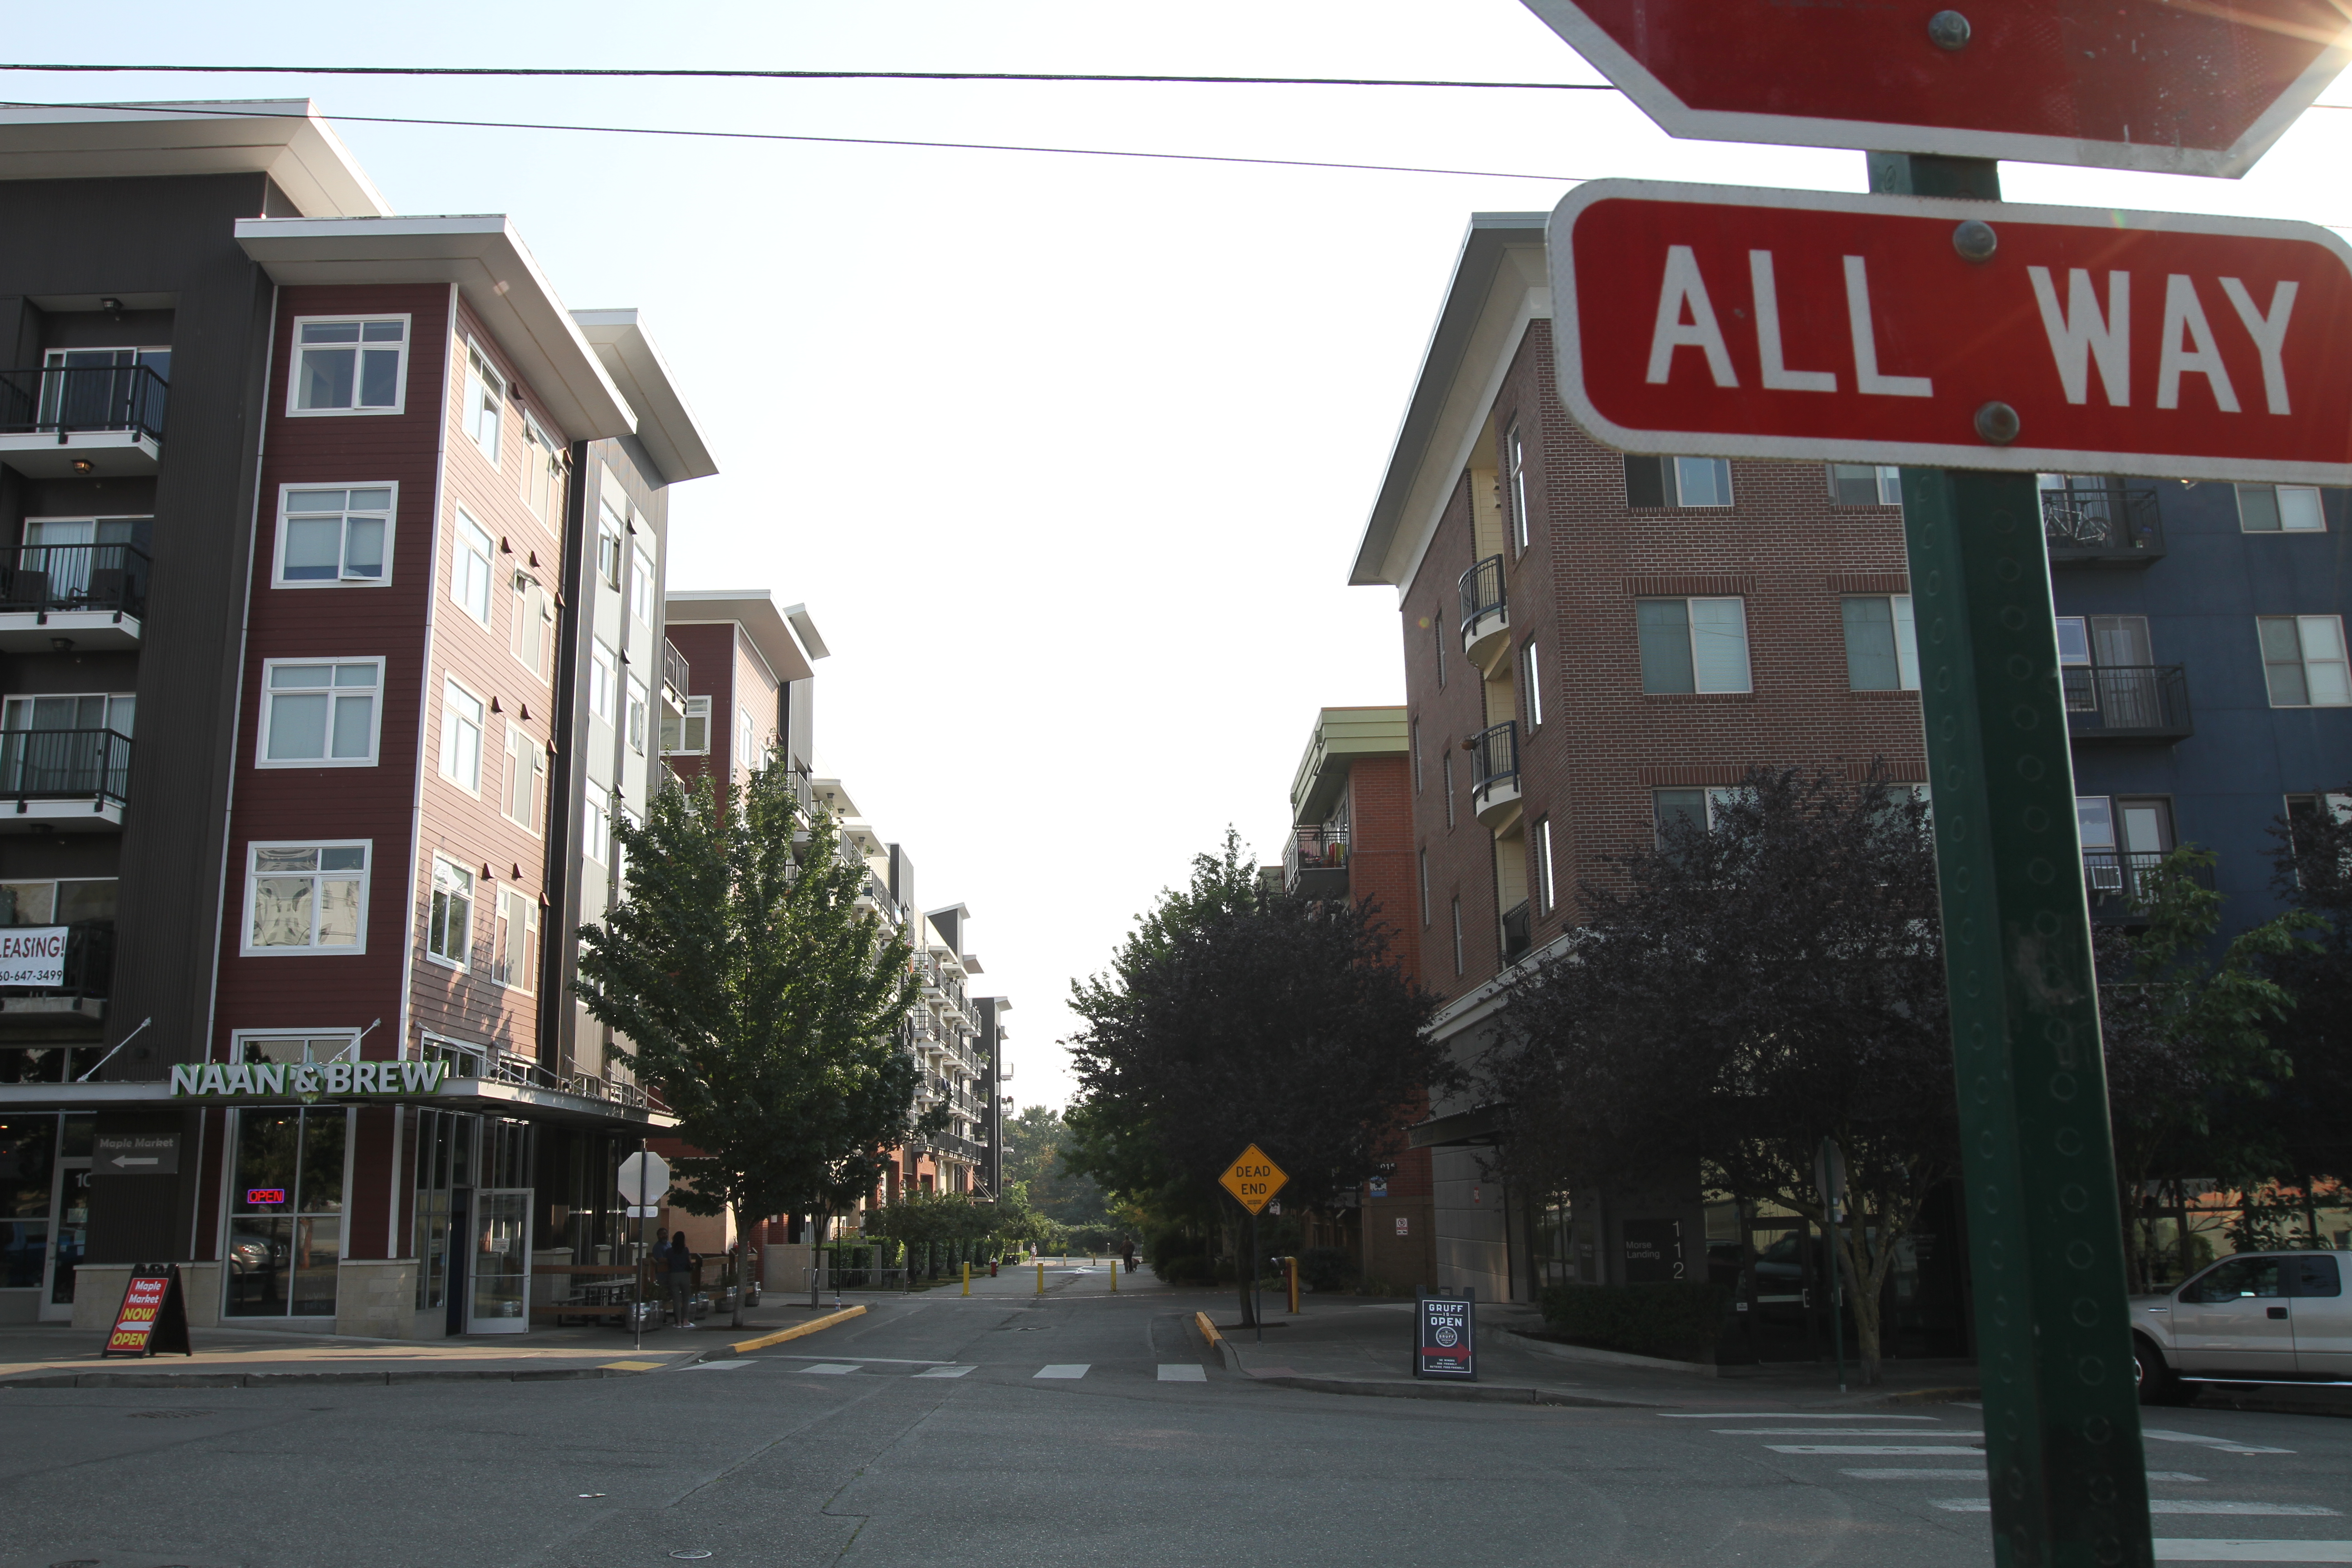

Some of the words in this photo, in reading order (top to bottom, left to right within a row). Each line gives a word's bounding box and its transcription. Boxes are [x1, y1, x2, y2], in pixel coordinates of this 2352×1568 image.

[1646, 245, 1933, 397] ALL
[2028, 265, 2298, 415] WAY
[0, 936, 65, 958] EASING!
[170, 1063, 288, 1096] NAAN
[294, 1066, 319, 1093] &
[327, 1062, 446, 1094] BREW
[100, 1139, 132, 1149] Maple
[135, 1138, 173, 1147] Market
[1236, 1166, 1270, 1177] DEAD
[1241, 1183, 1267, 1195] END
[249, 1191, 282, 1202] OPEN
[1627, 1250, 1660, 1259] Landing
[135, 1281, 161, 1291] Maple
[128, 1294, 159, 1303] Market
[1429, 1304, 1463, 1312] GRUFF
[122, 1308, 155, 1320] NOW
[1431, 1317, 1462, 1327] OPEN
[112, 1333, 147, 1345] OPEN
